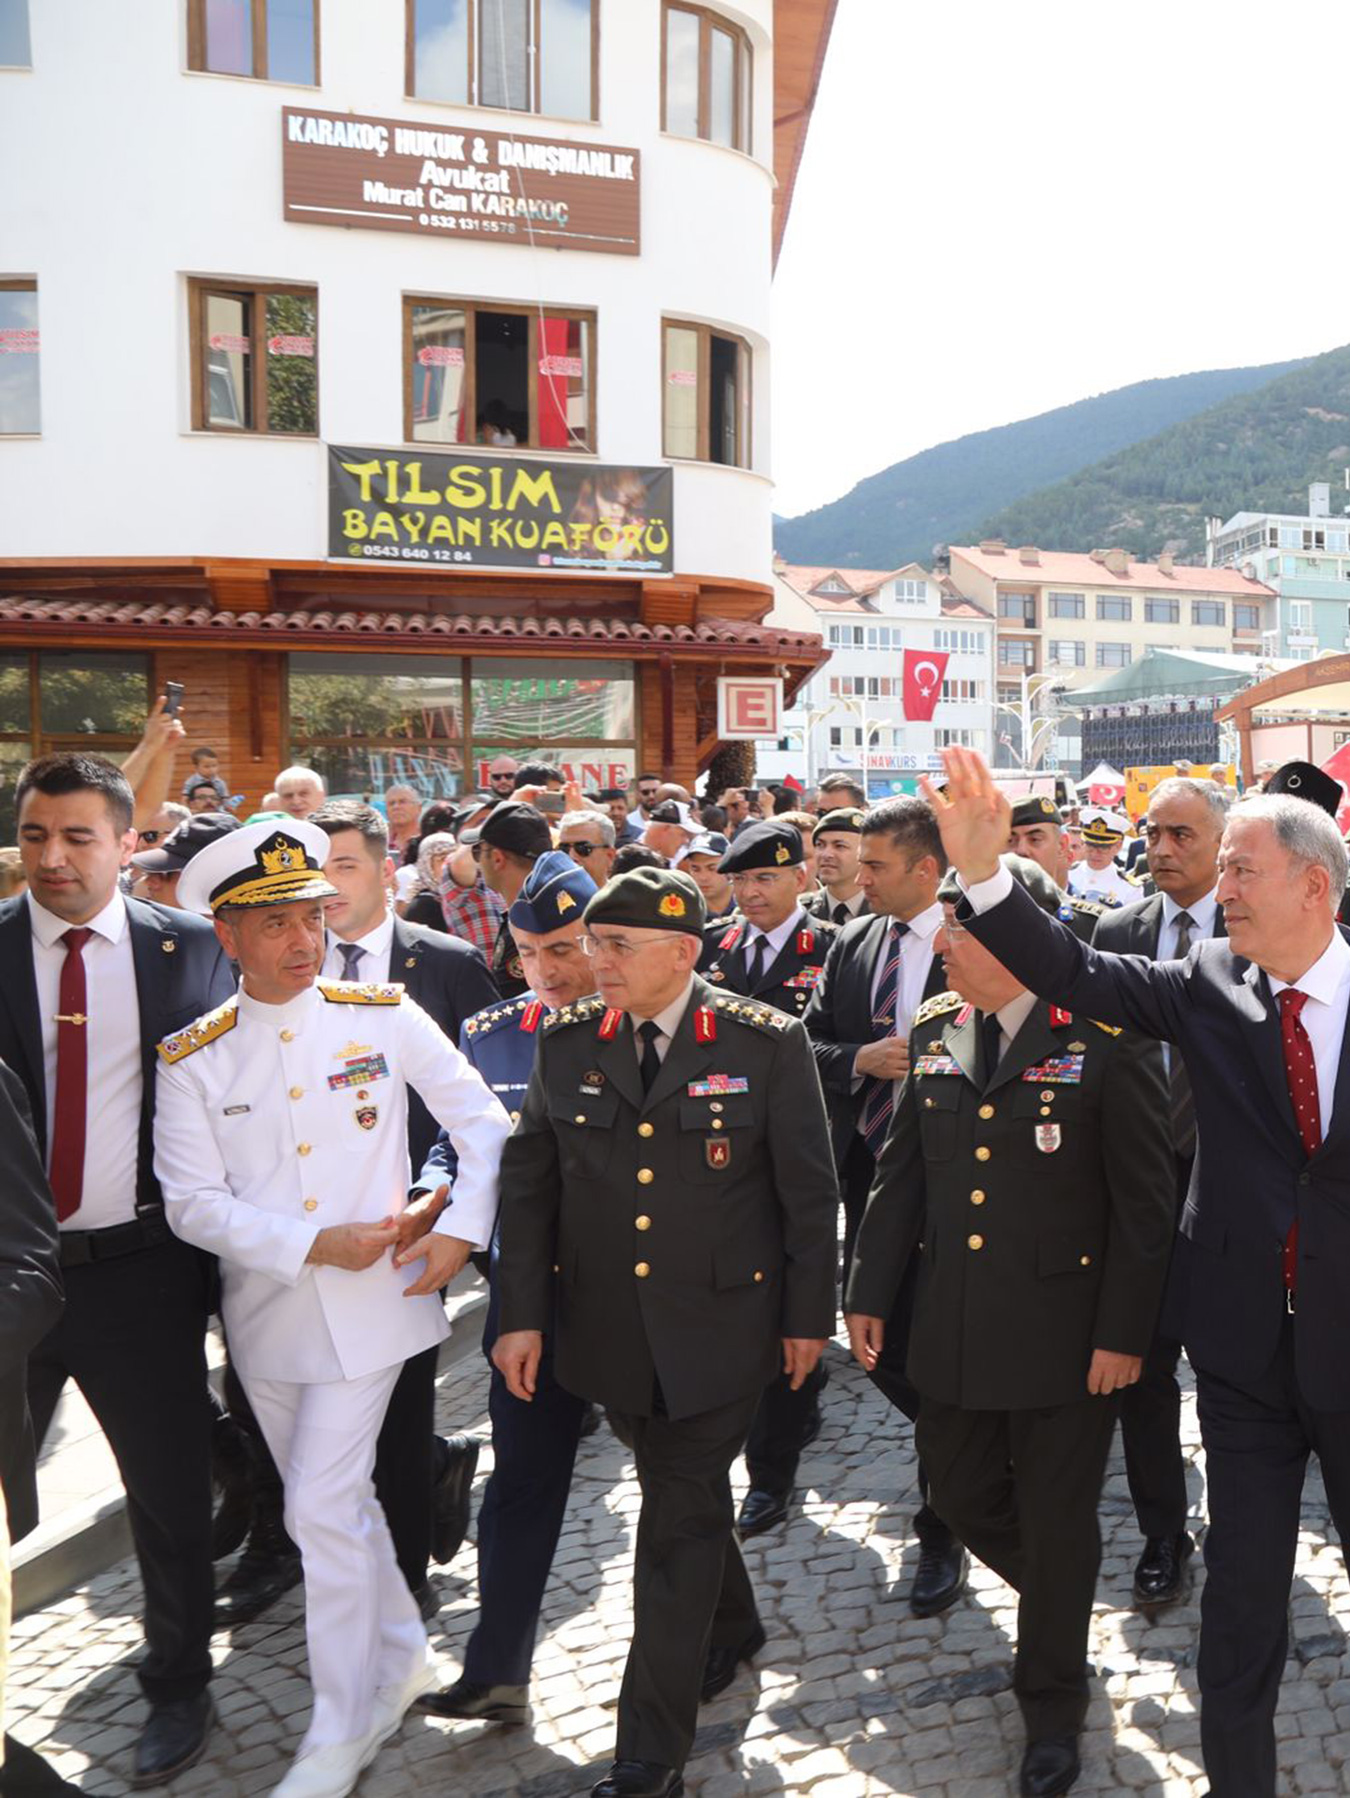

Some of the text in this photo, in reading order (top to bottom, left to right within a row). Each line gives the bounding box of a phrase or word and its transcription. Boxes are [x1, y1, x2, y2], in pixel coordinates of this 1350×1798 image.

[288, 115, 634, 181] KARAKOÇ HUKUK & DANIŞMANLIK
[419, 161, 510, 194] Avukat
[363, 181, 568, 228] Murat Can KARAKOÇ
[341, 459, 562, 514] TILSIM
[342, 509, 670, 554] BAYAN KUAFÖRÜ
[363, 544, 473, 563] 0543 640 12 84
[737, 690, 767, 726] E
